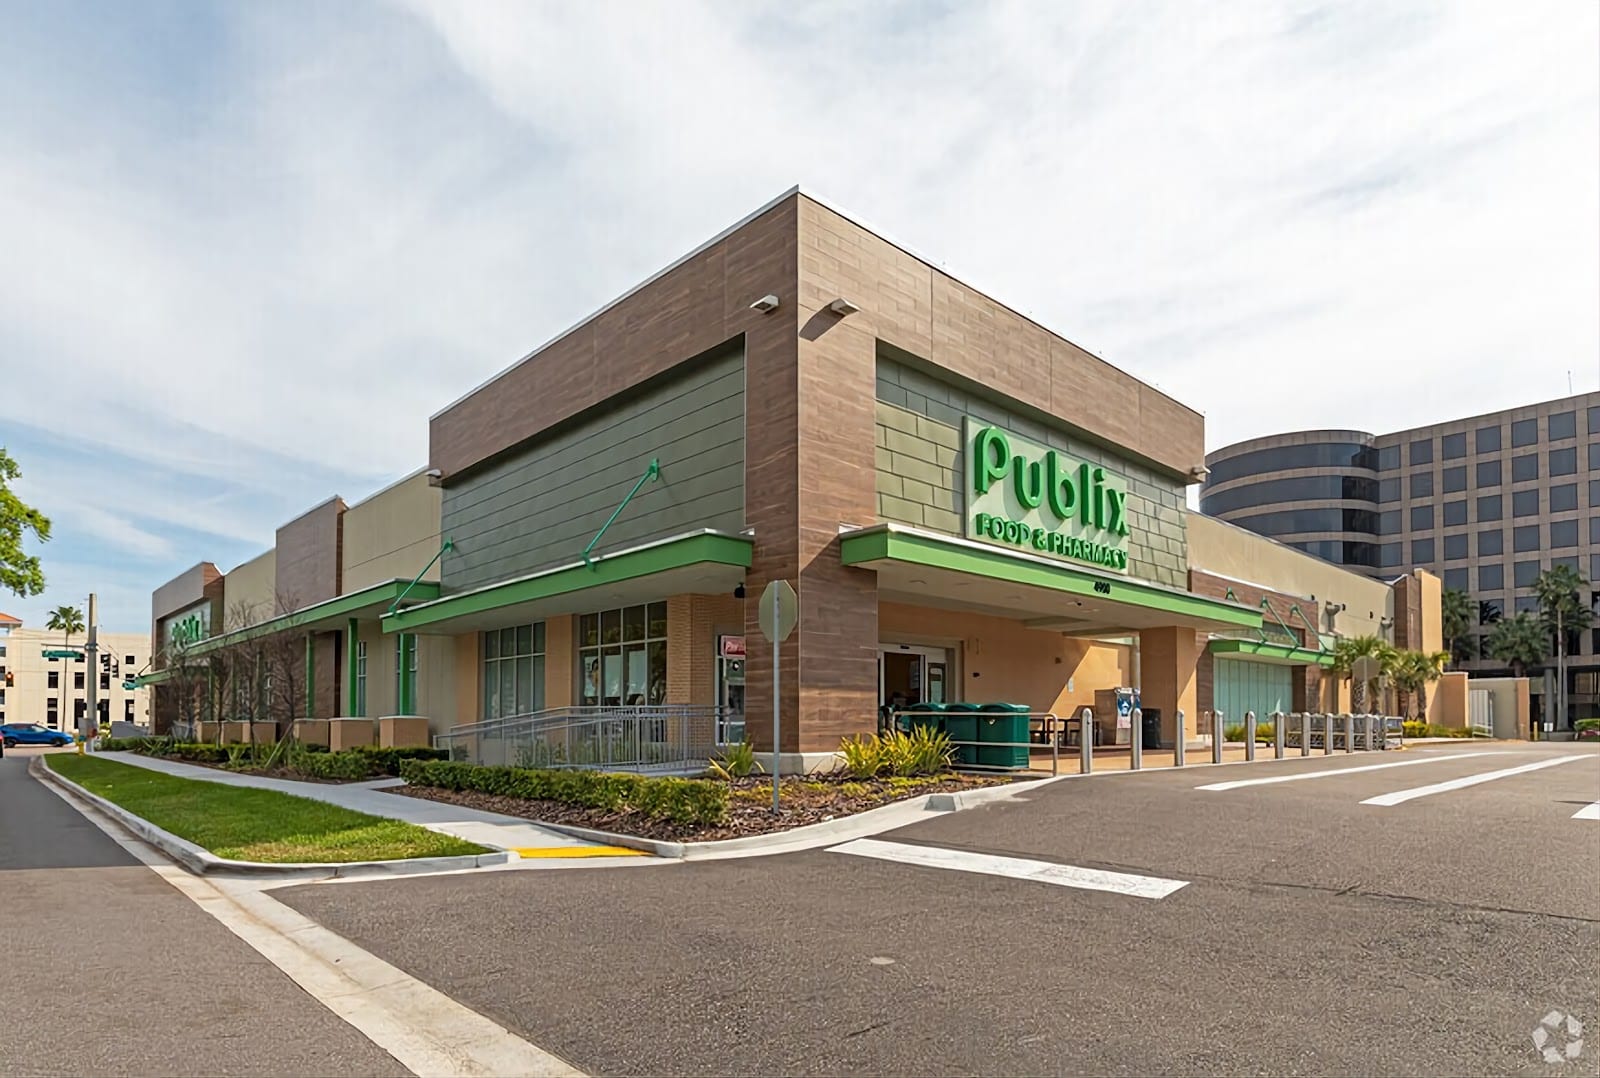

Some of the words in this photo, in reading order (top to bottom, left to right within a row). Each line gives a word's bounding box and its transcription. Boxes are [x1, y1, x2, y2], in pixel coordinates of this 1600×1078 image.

[974, 427, 1129, 536] Publix
[976, 512, 1031, 544] FOOD
[1032, 528, 1047, 550] &
[1047, 531, 1128, 570] PHARMACY
